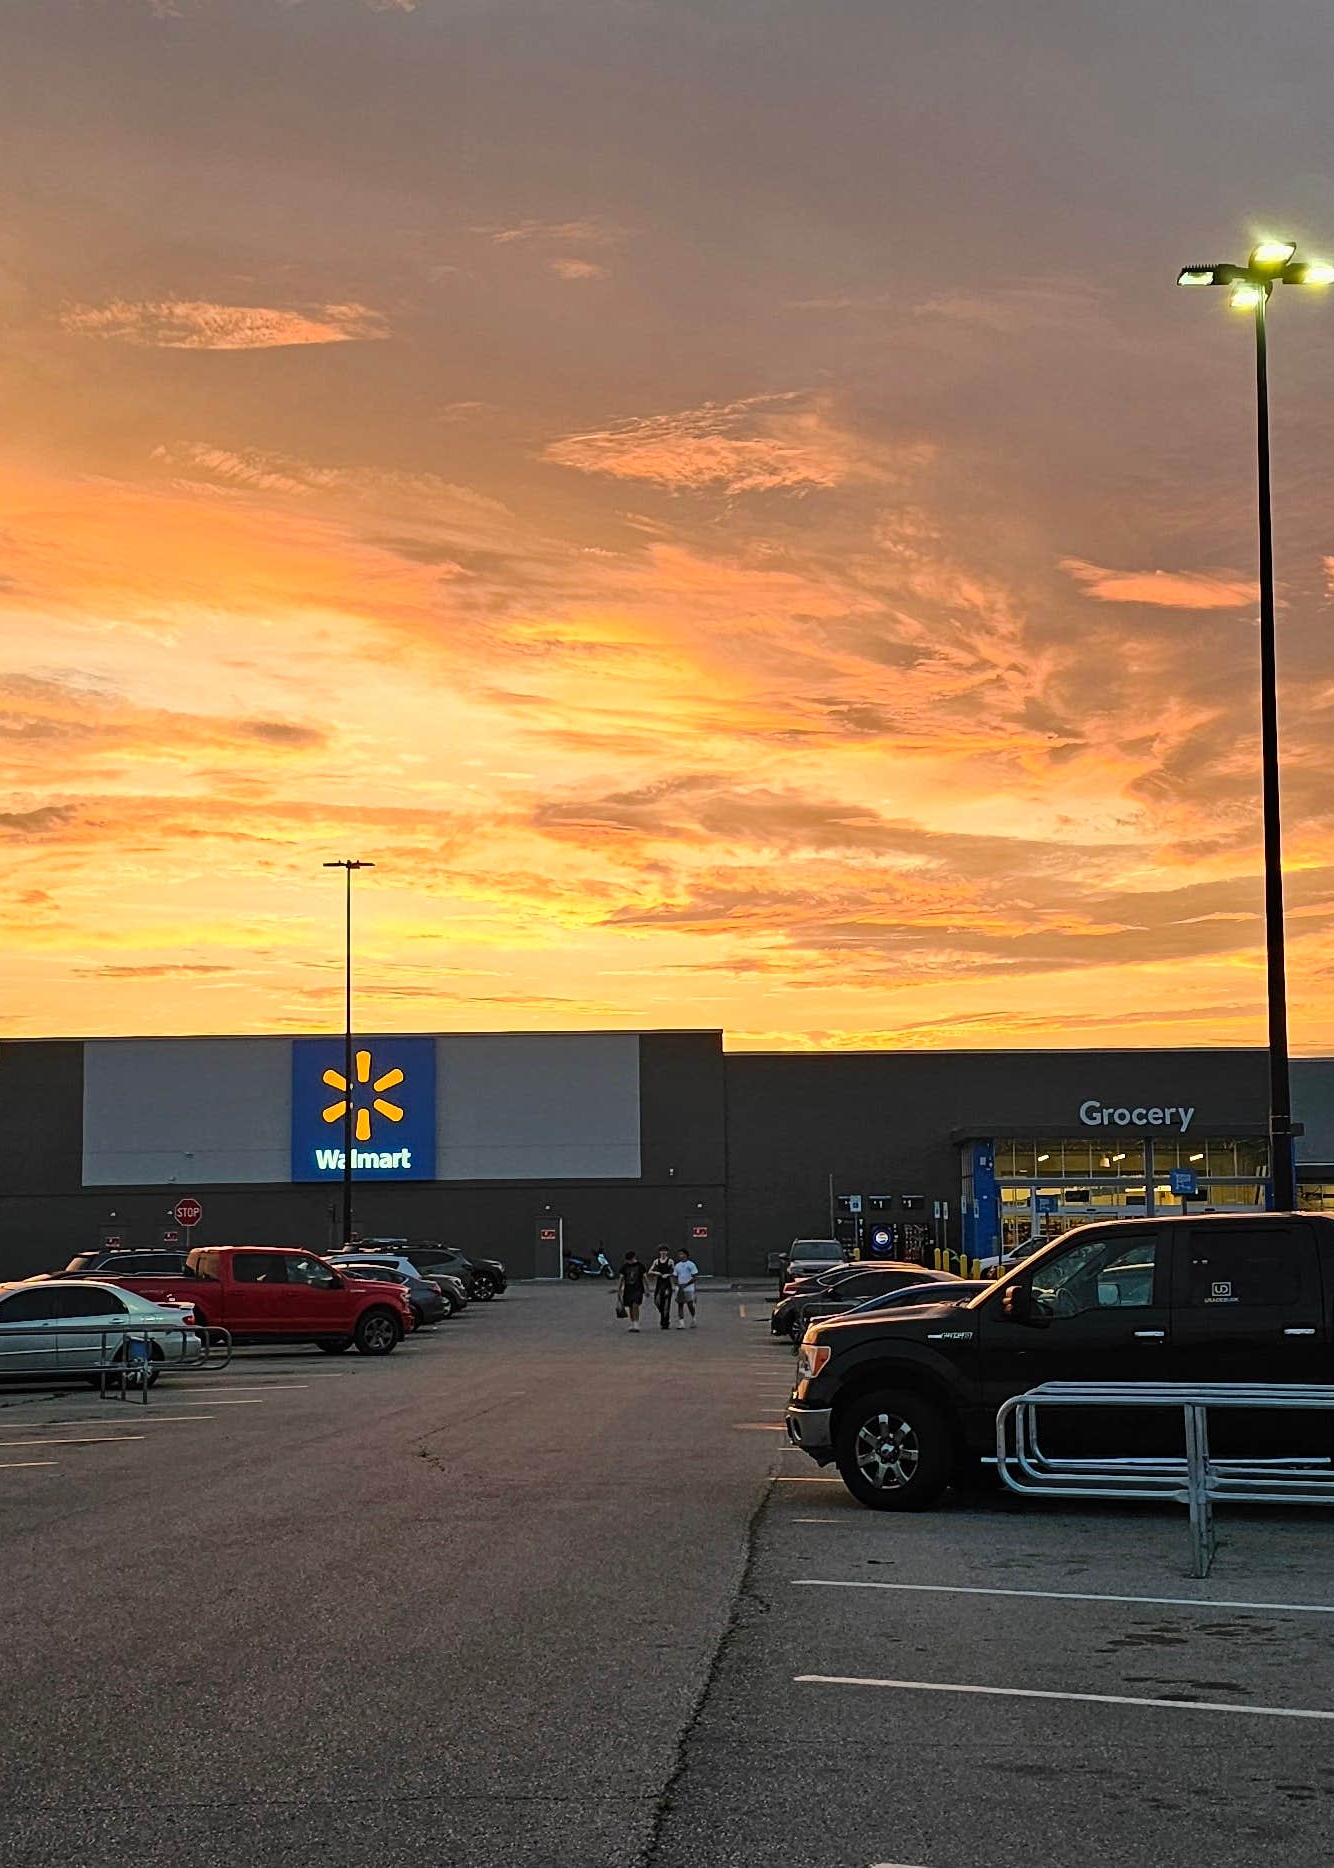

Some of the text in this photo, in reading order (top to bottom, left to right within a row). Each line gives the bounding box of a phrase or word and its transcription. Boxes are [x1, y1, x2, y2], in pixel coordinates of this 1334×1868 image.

[1079, 1101, 1195, 1132] Grocery
[315, 1148, 411, 1170] Walmart
[177, 1207, 200, 1219] STOP
